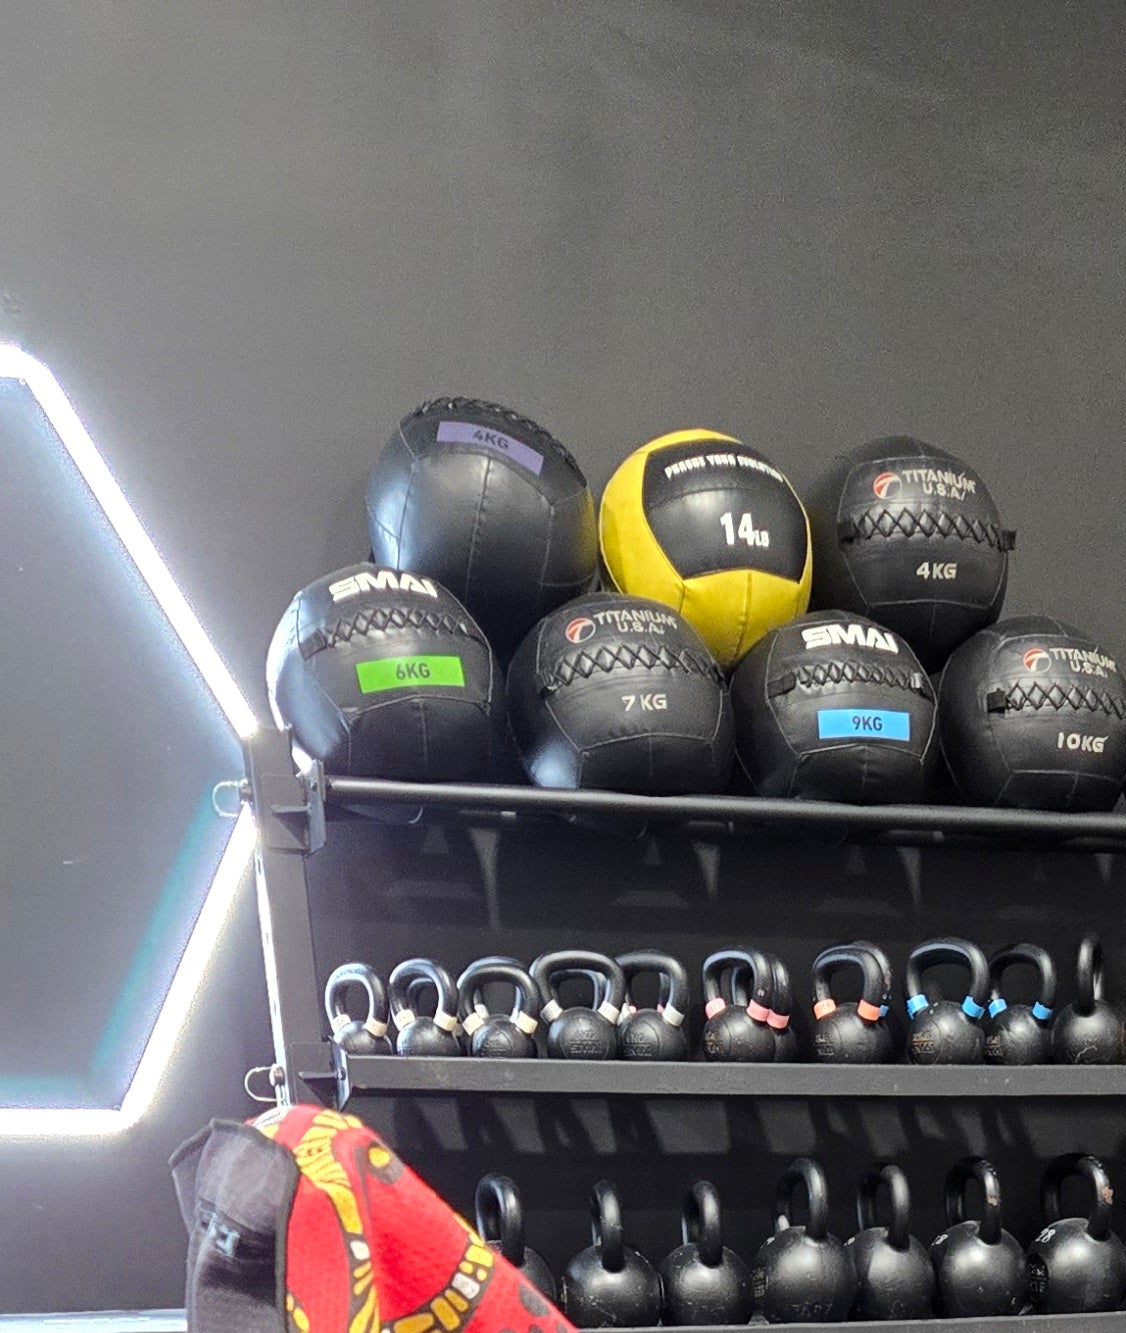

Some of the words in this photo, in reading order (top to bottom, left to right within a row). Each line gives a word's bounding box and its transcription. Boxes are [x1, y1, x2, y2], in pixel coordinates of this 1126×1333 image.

[473, 428, 509, 450] 4KG
[902, 469, 976, 494] TITANIUM
[328, 570, 438, 603] SMAI
[593, 609, 678, 630] TITANIUM
[801, 623, 899, 654] SMAI
[396, 662, 431, 680] 6KG
[1049, 647, 1117, 673] TITANIUM
[852, 715, 883, 732] 9KG
